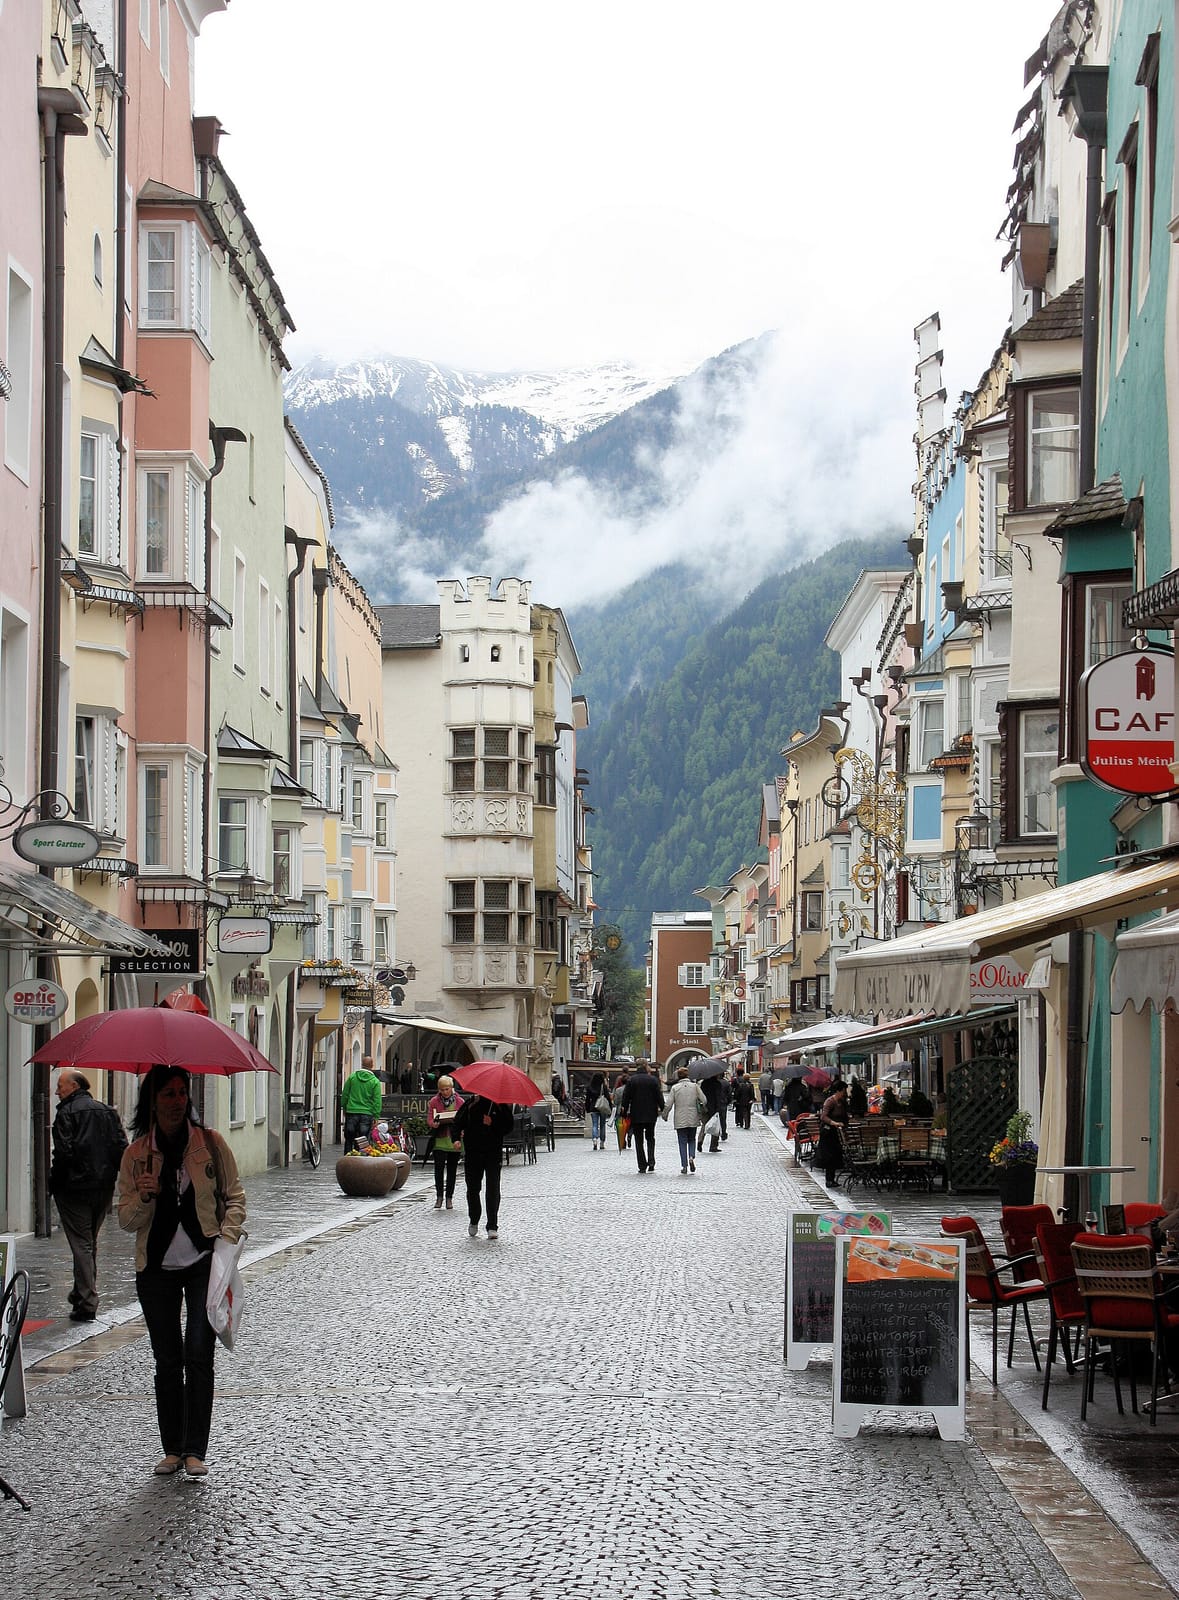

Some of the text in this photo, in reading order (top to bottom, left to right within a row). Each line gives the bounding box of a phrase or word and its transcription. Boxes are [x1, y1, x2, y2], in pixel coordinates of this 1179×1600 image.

[1095, 707, 1175, 732] CAF
[1092, 756, 1133, 766] Julius
[33, 838, 86, 848] Sport Gartner
[119, 961, 191, 970] SELECTION
[970, 962, 1030, 989] s.Olive
[13, 990, 56, 1006] optic
[13, 1004, 56, 1020] rapid
[401, 1096, 430, 1113] HÄU
